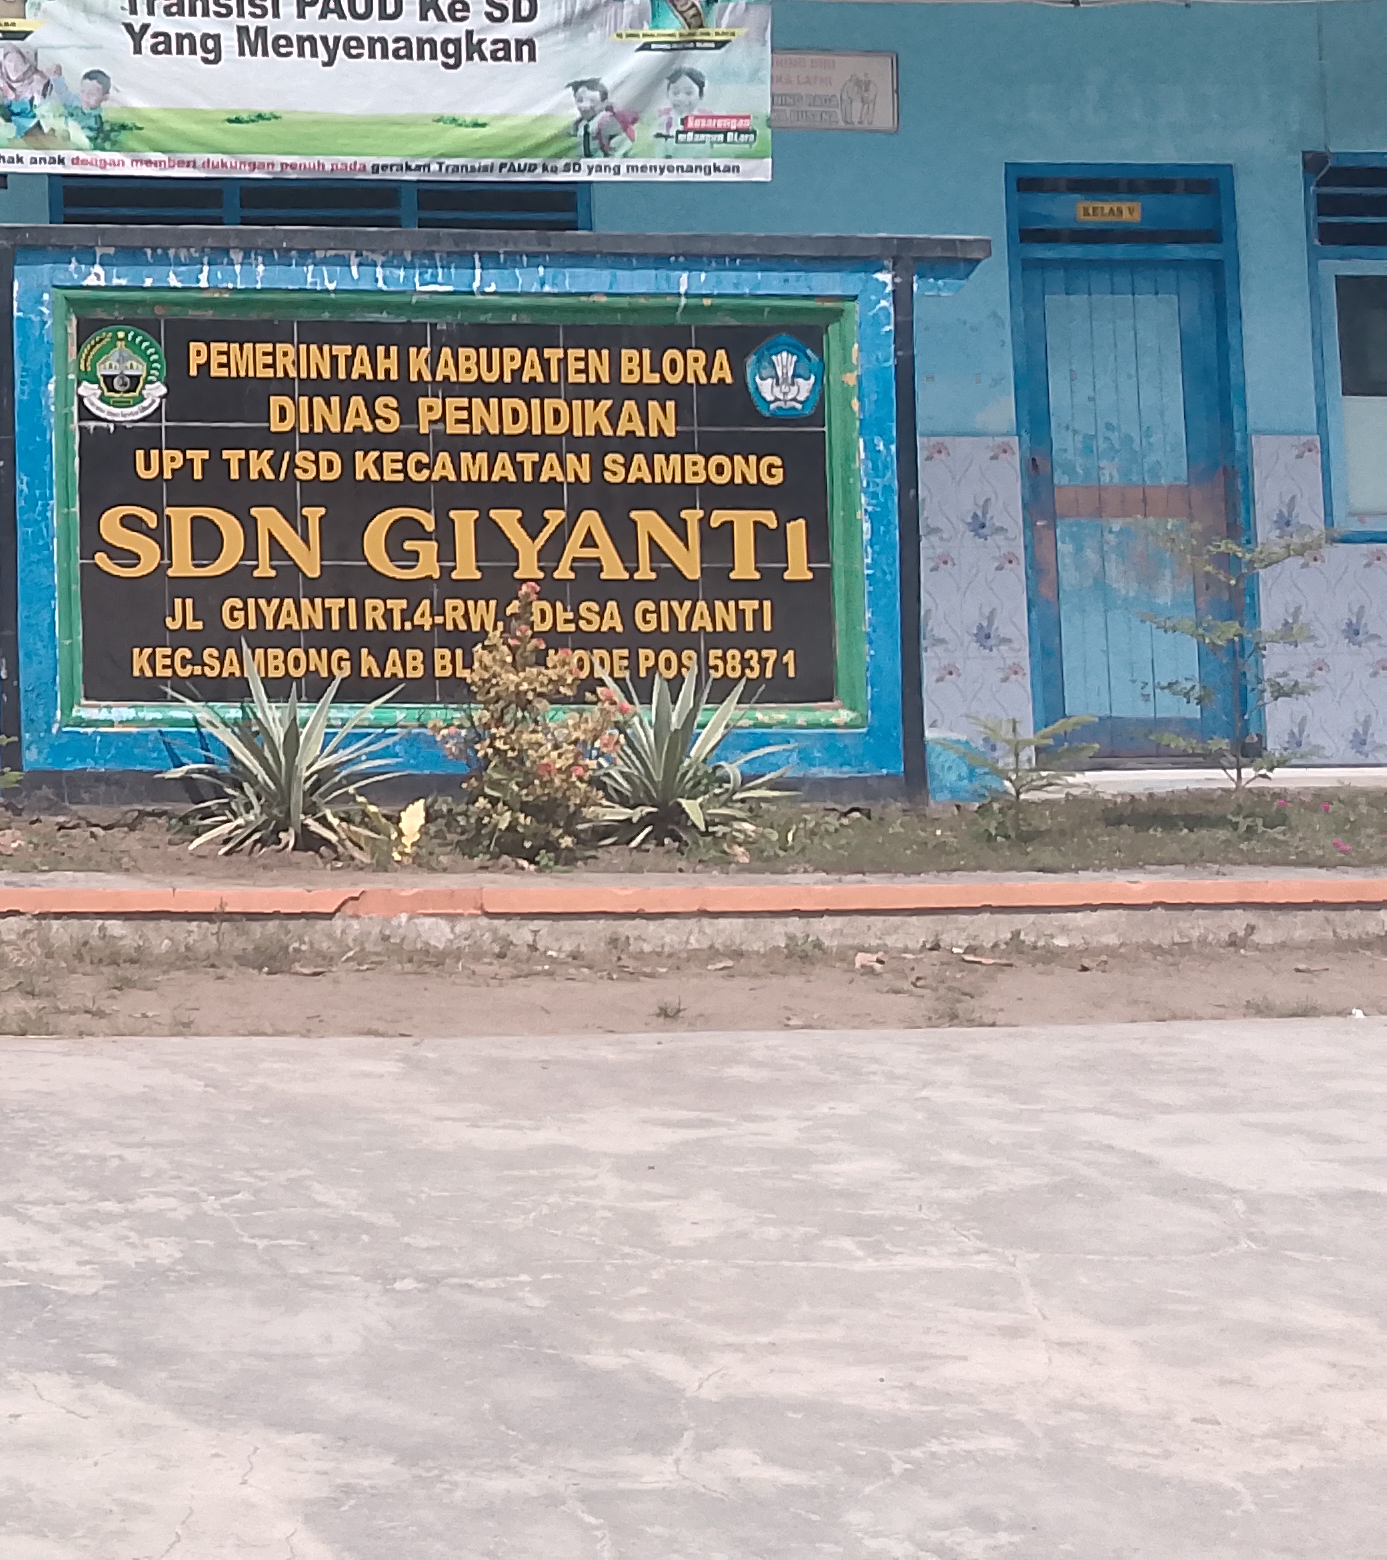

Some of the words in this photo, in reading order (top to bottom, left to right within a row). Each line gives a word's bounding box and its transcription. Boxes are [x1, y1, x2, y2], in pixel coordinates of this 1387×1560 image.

[122, 23, 222, 65] Yang
[236, 25, 537, 70] Menyenangkan
[29, 154, 65, 165] anak
[71, 156, 125, 169] dengan
[130, 157, 196, 168] memberi
[201, 158, 275, 172] dukungan
[280, 160, 325, 171] penuh
[330, 160, 366, 173] pada
[371, 161, 430, 174] gerakan
[435, 161, 494, 173] Transisi
[498, 162, 537, 173] PAUD
[541, 162, 558, 173] ke
[562, 163, 581, 173] SD
[586, 164, 621, 175] yang
[626, 164, 740, 176] menyenangkan
[1083, 206, 1123, 217] KELAS
[1127, 206, 1135, 216] V
[188, 341, 399, 381] PEMERINTAH
[408, 346, 610, 384] KABUPATEN
[620, 348, 733, 384] BLORA
[269, 395, 401, 434] DINAS
[417, 397, 677, 438] PENDIDIKAN
[135, 449, 210, 480] UPT
[222, 449, 342, 482] TK/SD
[354, 450, 591, 484] KECAMATAN
[603, 452, 784, 485] SAMBONG
[94, 505, 326, 578] SDN
[165, 598, 203, 631] JL
[222, 598, 357, 631] GIYANTI
[533, 600, 623, 633] DESA
[635, 600, 772, 633] GIYANTI
[547, 649, 629, 680] ODE
[639, 650, 698, 679] POS
[709, 650, 796, 679] 58371
